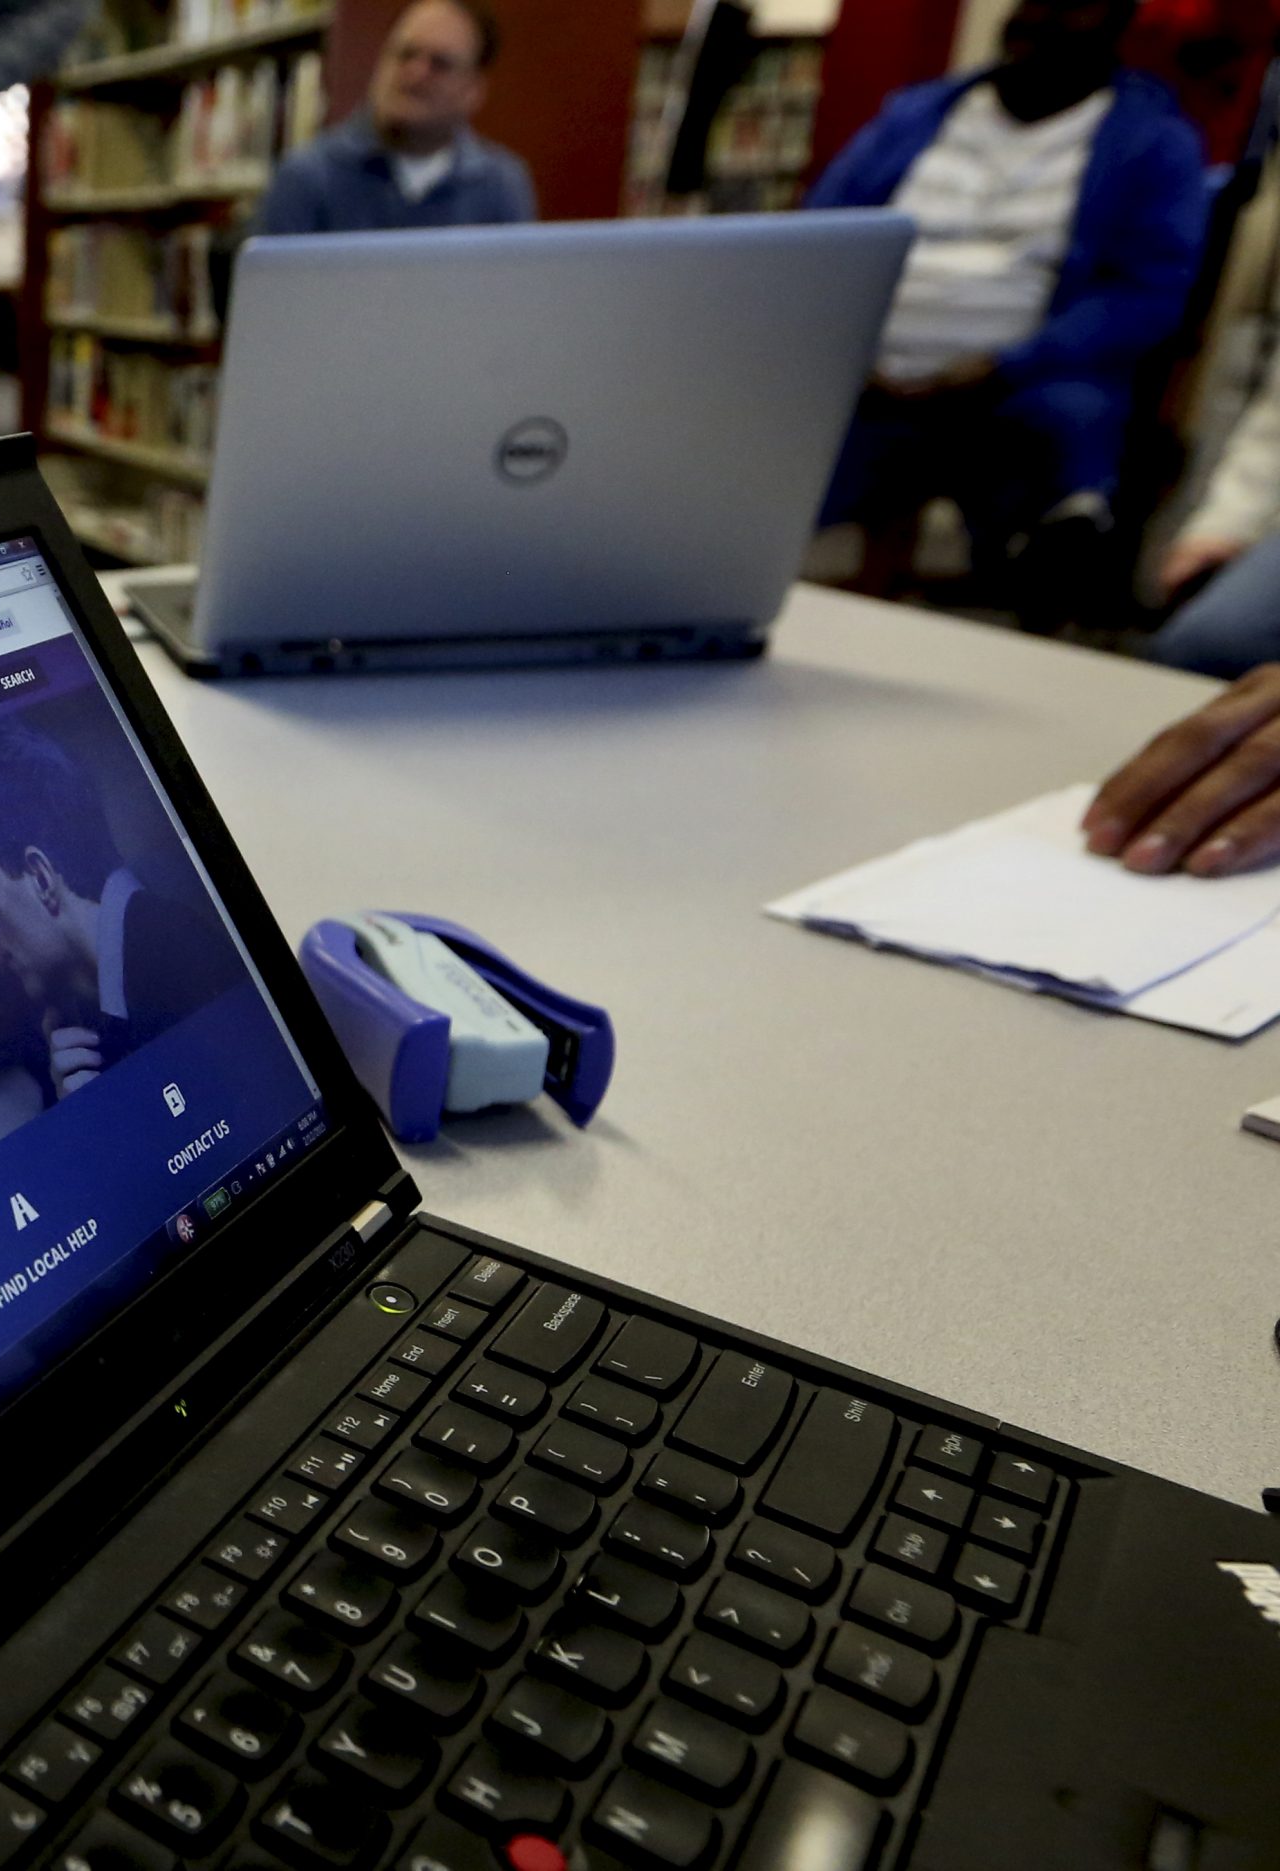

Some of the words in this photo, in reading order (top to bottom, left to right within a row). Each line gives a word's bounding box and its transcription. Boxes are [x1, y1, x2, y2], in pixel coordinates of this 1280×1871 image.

[0, 668, 35, 690] SEARCH
[167, 1130, 217, 1175] CONTACT
[214, 1119, 231, 1140] US
[24, 1244, 70, 1284] LOCAL
[66, 1218, 98, 1253] HELP
[474, 1260, 502, 1284] Delete
[433, 1308, 460, 1330] Insert
[542, 1291, 582, 1333] Backspace
[402, 1345, 424, 1363] End
[370, 1373, 401, 1399] Home
[741, 1362, 767, 1389] Enter
[843, 1398, 868, 1423] Shift
[337, 1415, 361, 1435] F12
[941, 1433, 963, 1457] PgDn
[300, 1454, 324, 1476] F11
[261, 1496, 288, 1518] F10
[424, 1492, 450, 1508] 0
[510, 1495, 538, 1516] P
[221, 1544, 243, 1563] F9
[381, 1544, 408, 1561] 9
[473, 1547, 504, 1568] O
[335, 1600, 363, 1621] 8
[588, 1589, 621, 1607] L
[126, 1641, 151, 1665] F7
[550, 1642, 586, 1670] K
[284, 1660, 313, 1685] 7
[382, 1665, 417, 1692] U
[511, 1710, 542, 1737] J
[229, 1727, 261, 1753] 6
[332, 1730, 368, 1758] Y
[647, 1729, 690, 1765] M
[461, 1776, 503, 1811] H
[169, 1802, 202, 1831] 5
[275, 1804, 313, 1836] T
[607, 1805, 650, 1842] N
